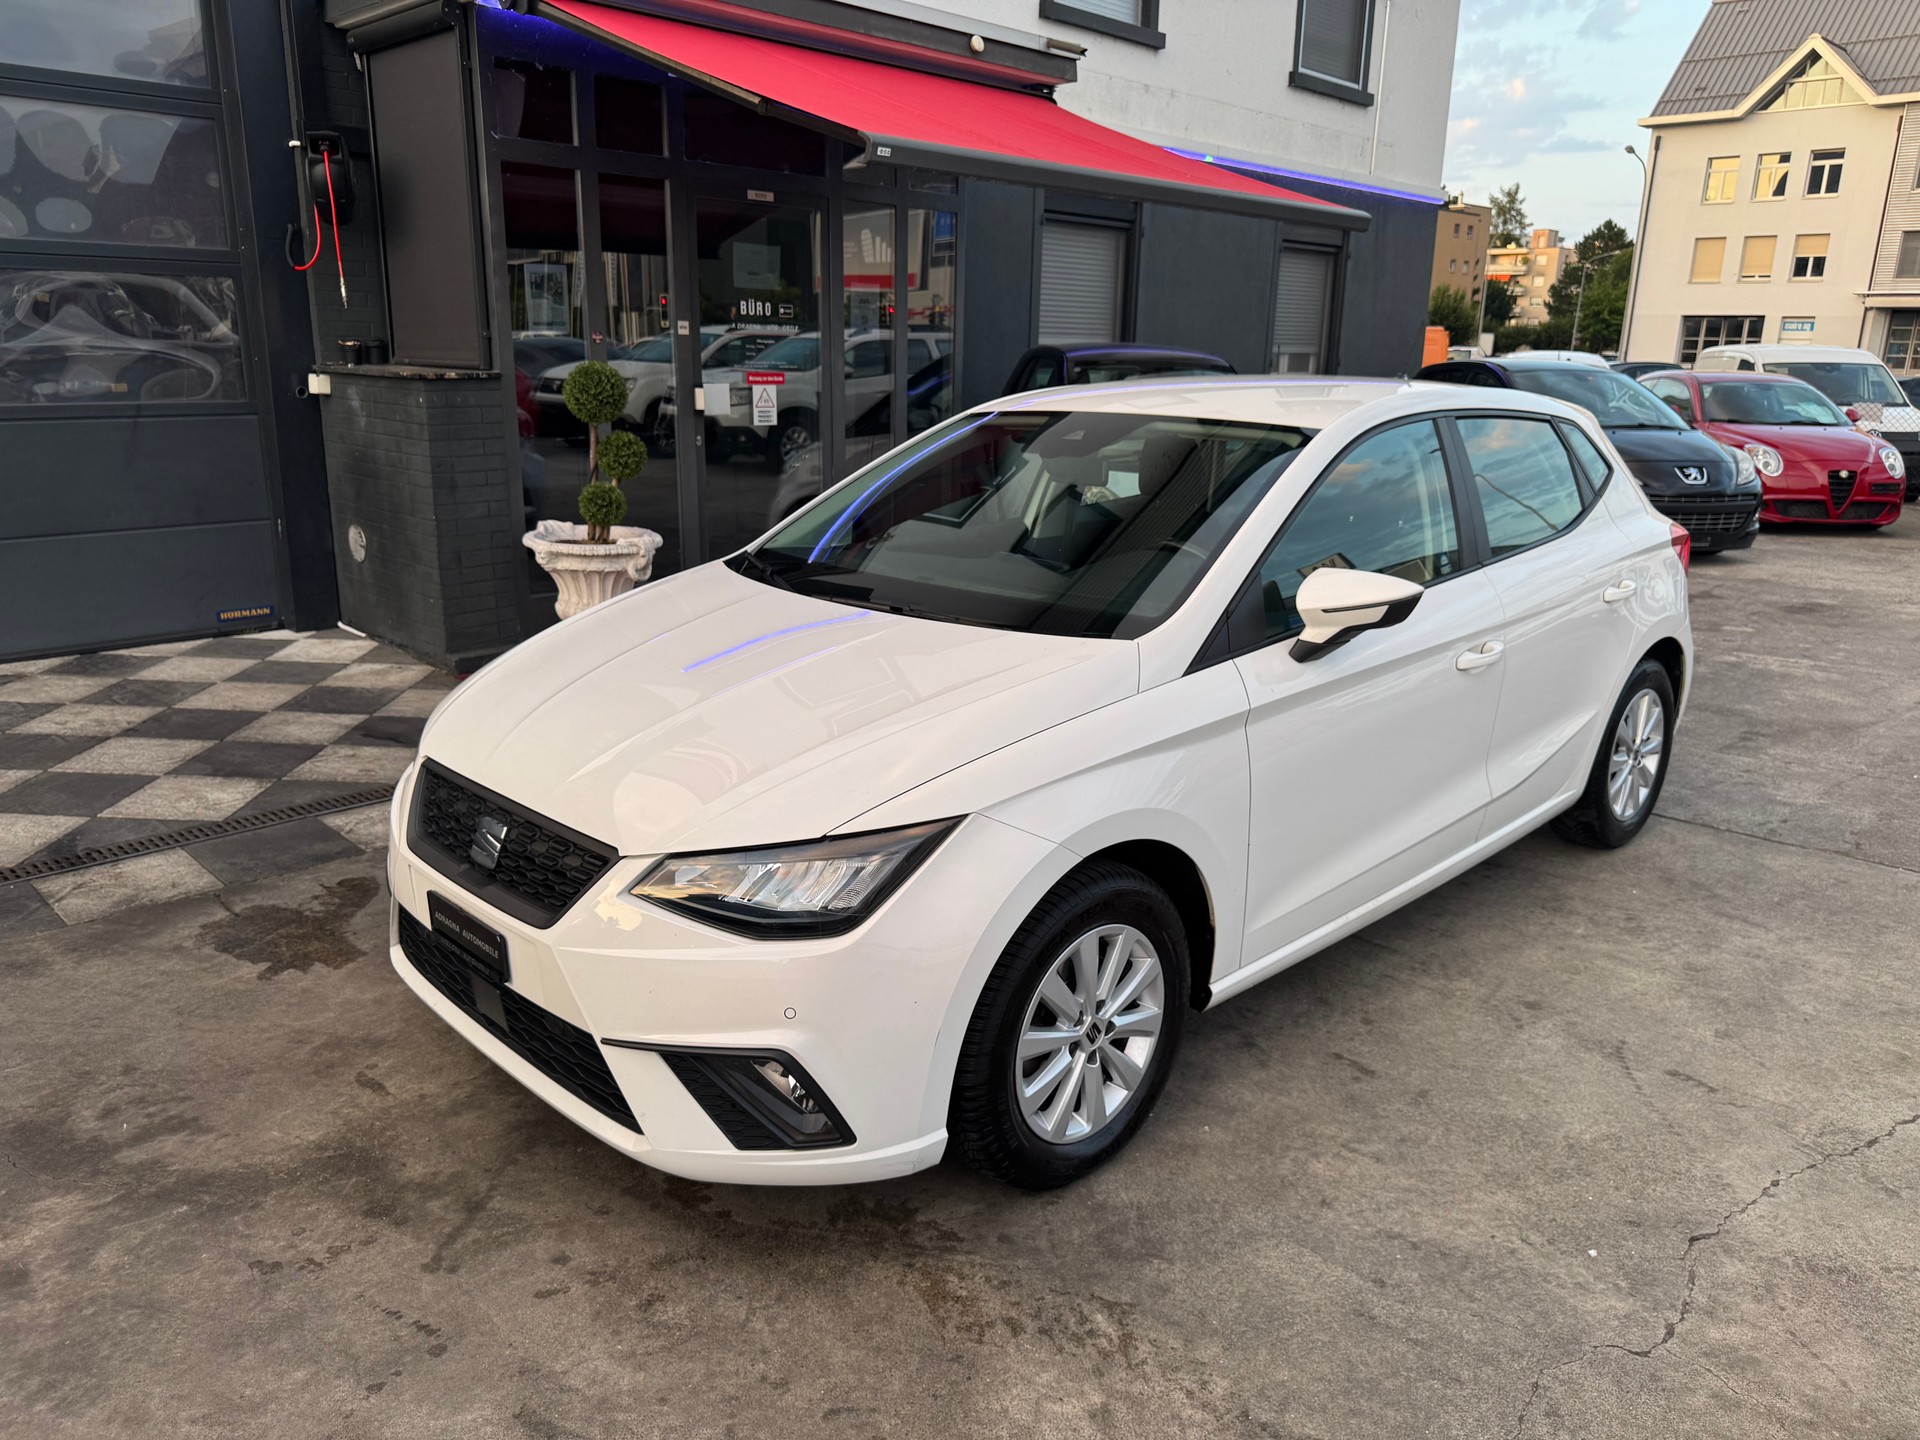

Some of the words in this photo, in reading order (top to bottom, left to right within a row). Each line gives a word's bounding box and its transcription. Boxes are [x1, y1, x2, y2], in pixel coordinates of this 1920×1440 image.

[740, 299, 772, 316] BÜRO
[434, 911, 461, 933] ADRAGNA
[462, 929, 499, 958] AUTOMOBILE
